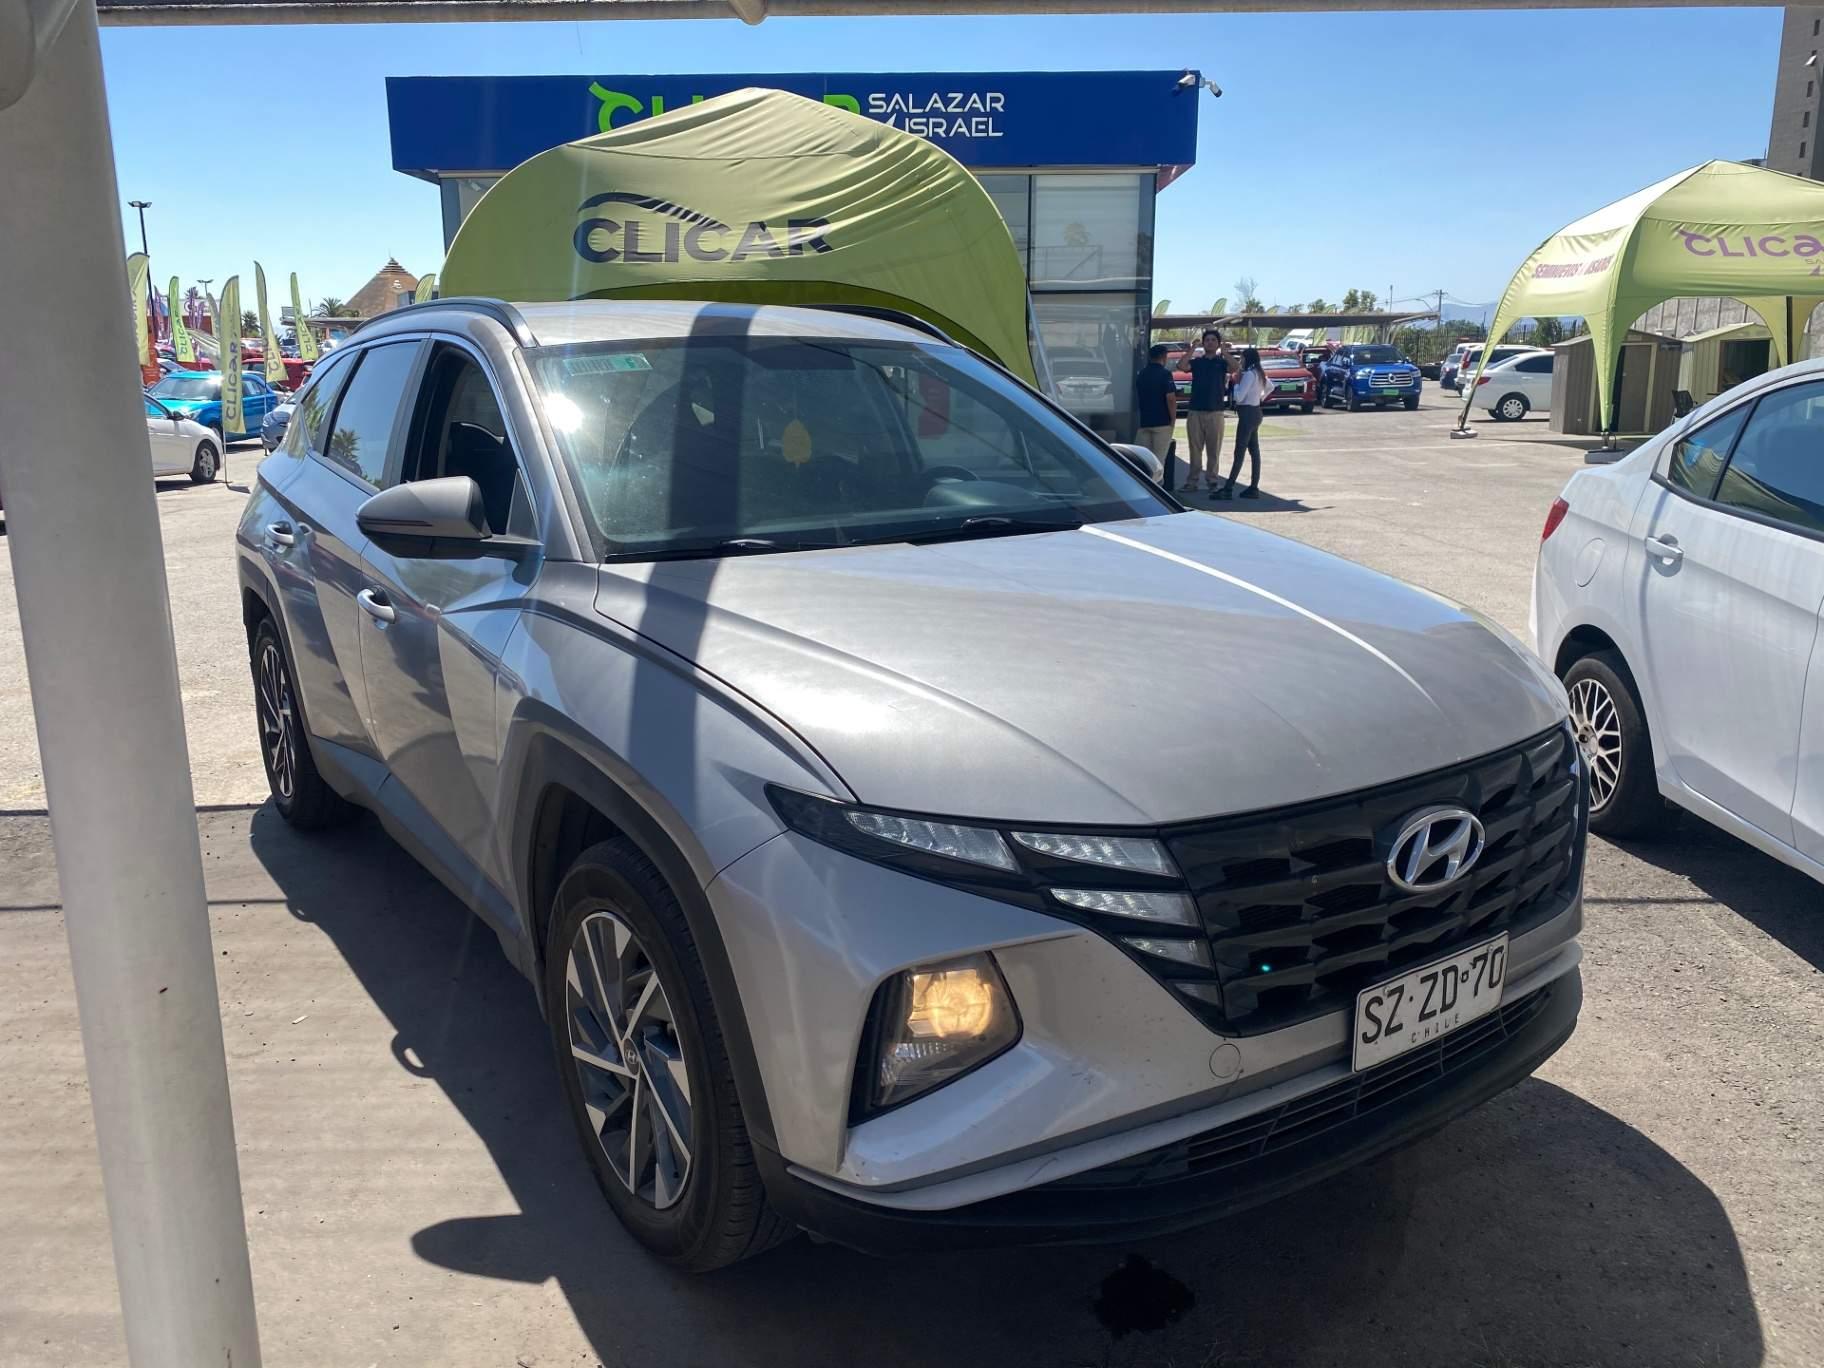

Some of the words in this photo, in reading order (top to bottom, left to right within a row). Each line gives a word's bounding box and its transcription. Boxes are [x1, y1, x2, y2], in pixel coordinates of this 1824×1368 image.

[868, 92, 1005, 114] SALAZAR
[905, 117, 1004, 138] ISRAEL
[573, 215, 834, 264] CLICAR
[1411, 1012, 1461, 1044] CHILE
